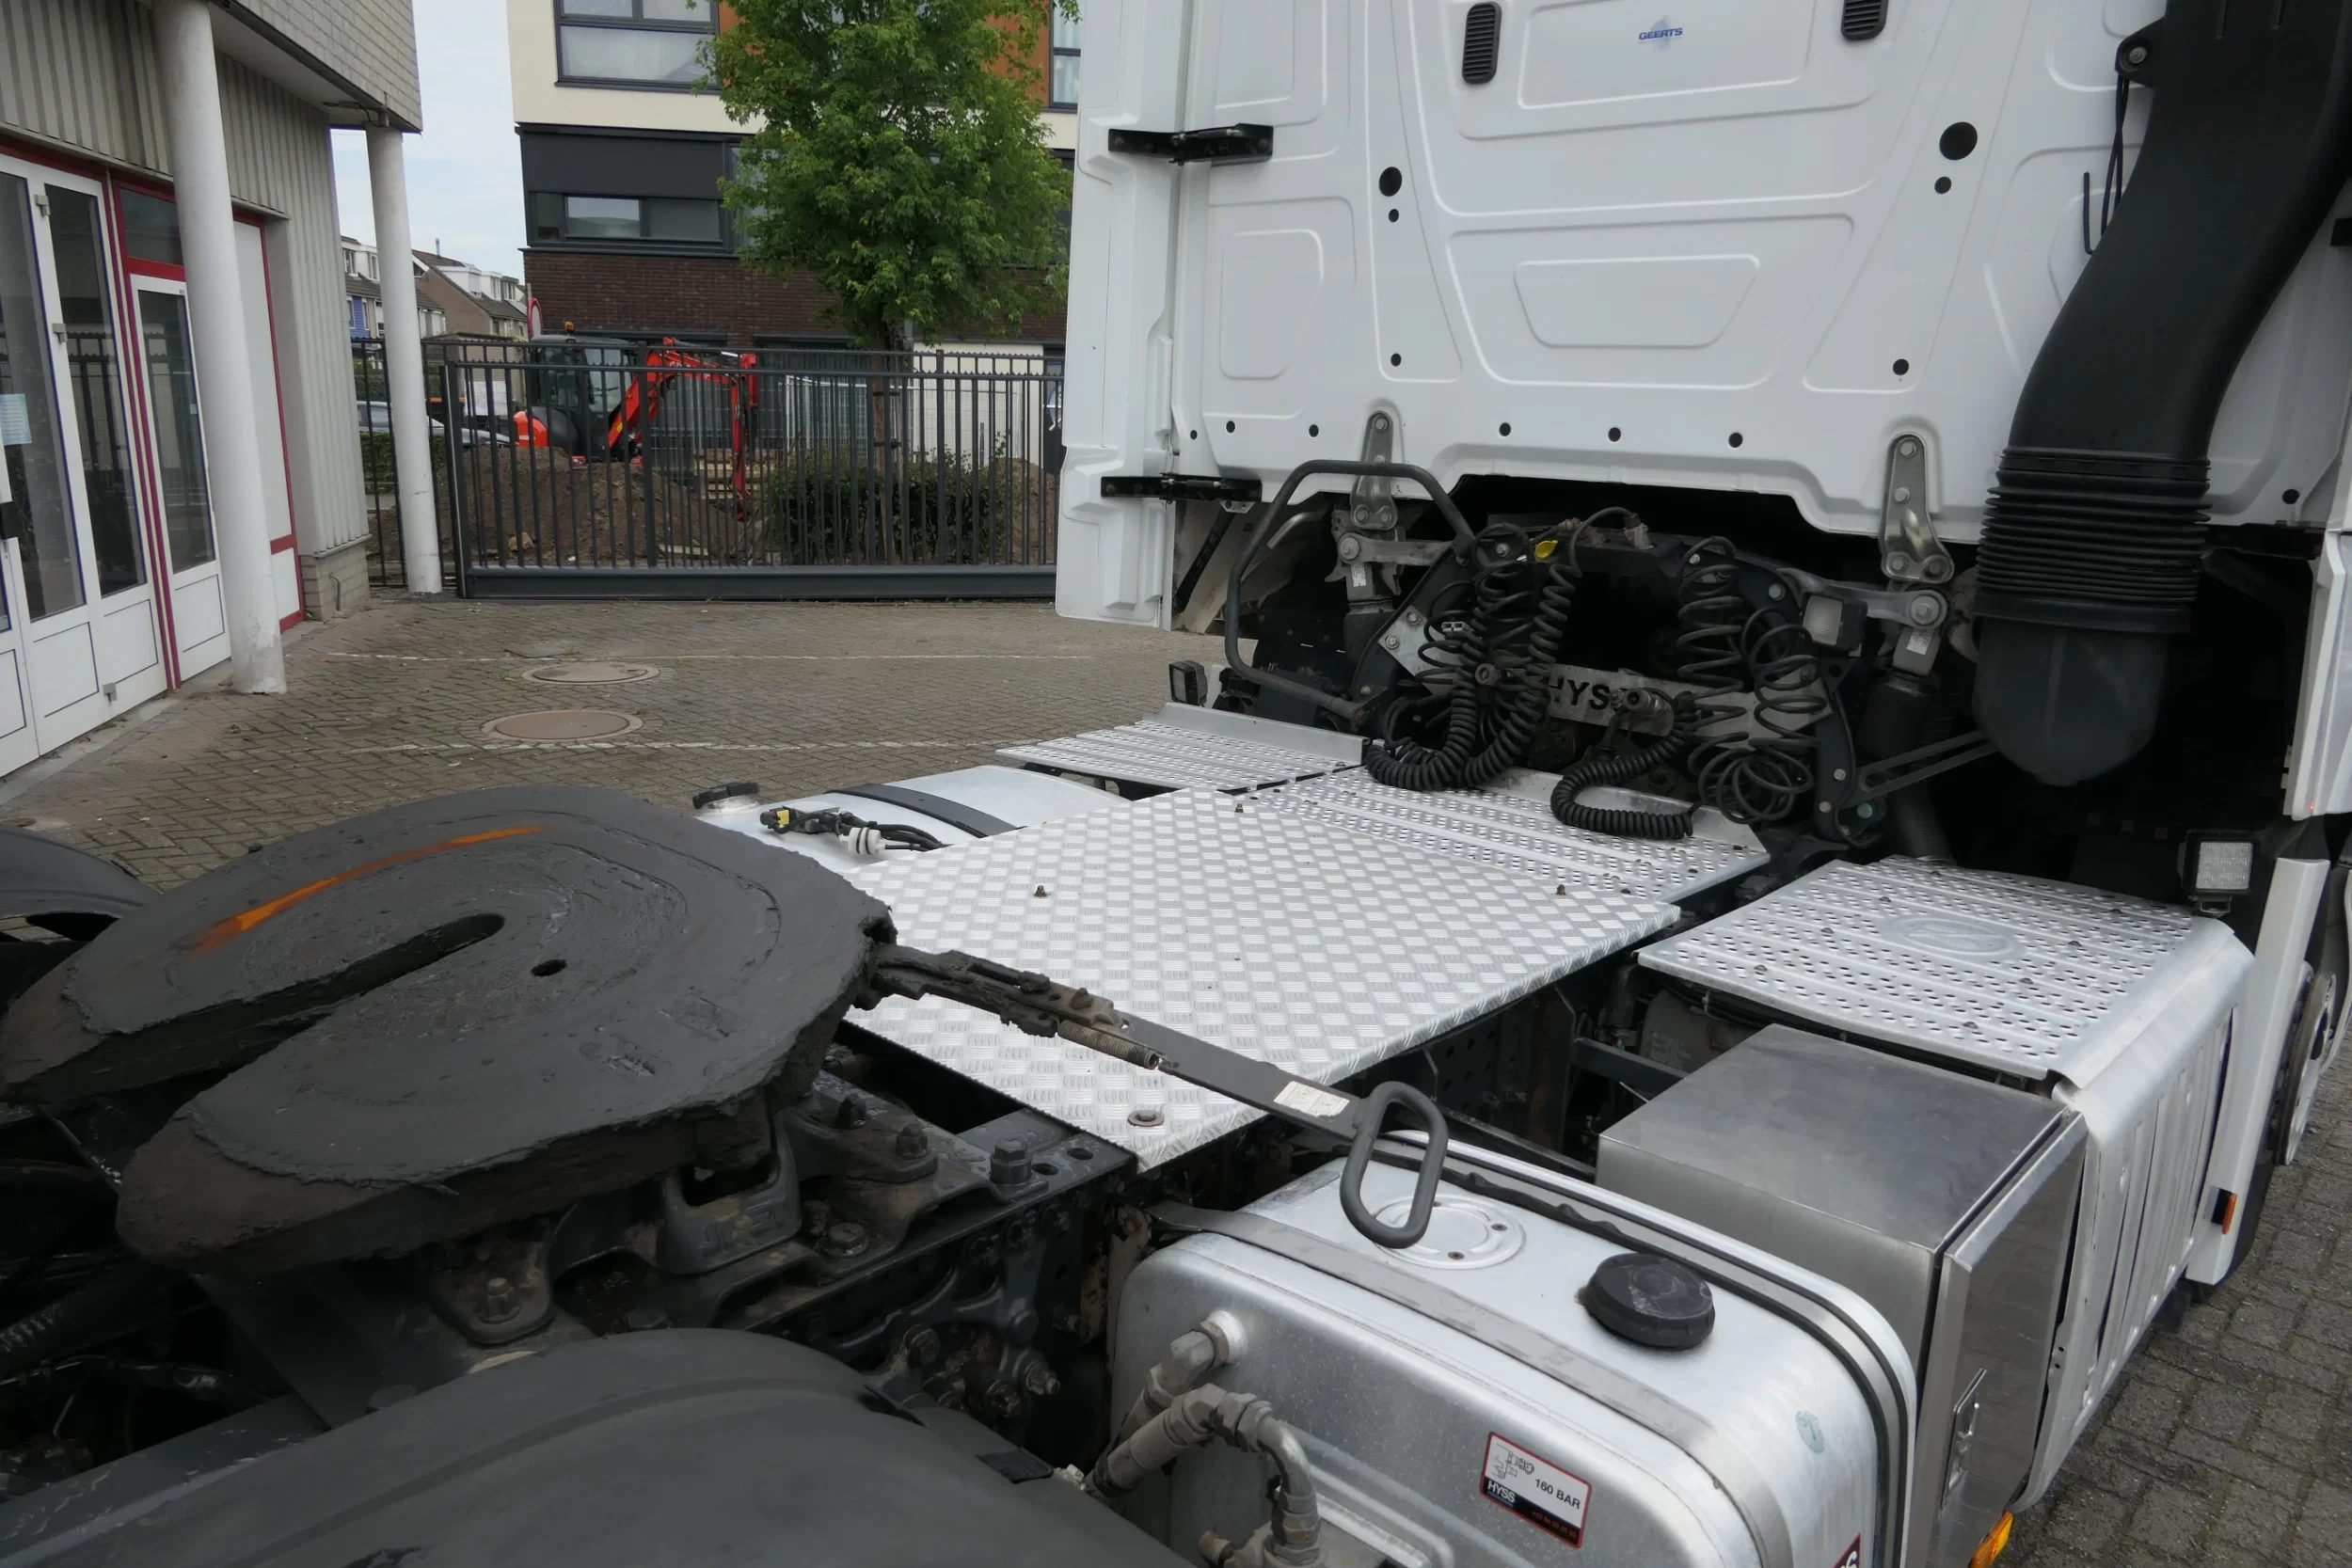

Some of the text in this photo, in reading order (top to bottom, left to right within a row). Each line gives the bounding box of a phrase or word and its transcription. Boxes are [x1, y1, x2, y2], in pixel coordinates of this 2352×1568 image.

[1639, 27, 1683, 40] GEERTS
[1487, 1480, 1516, 1502] HYSS
[1535, 1479, 1581, 1509] 160 BAR
